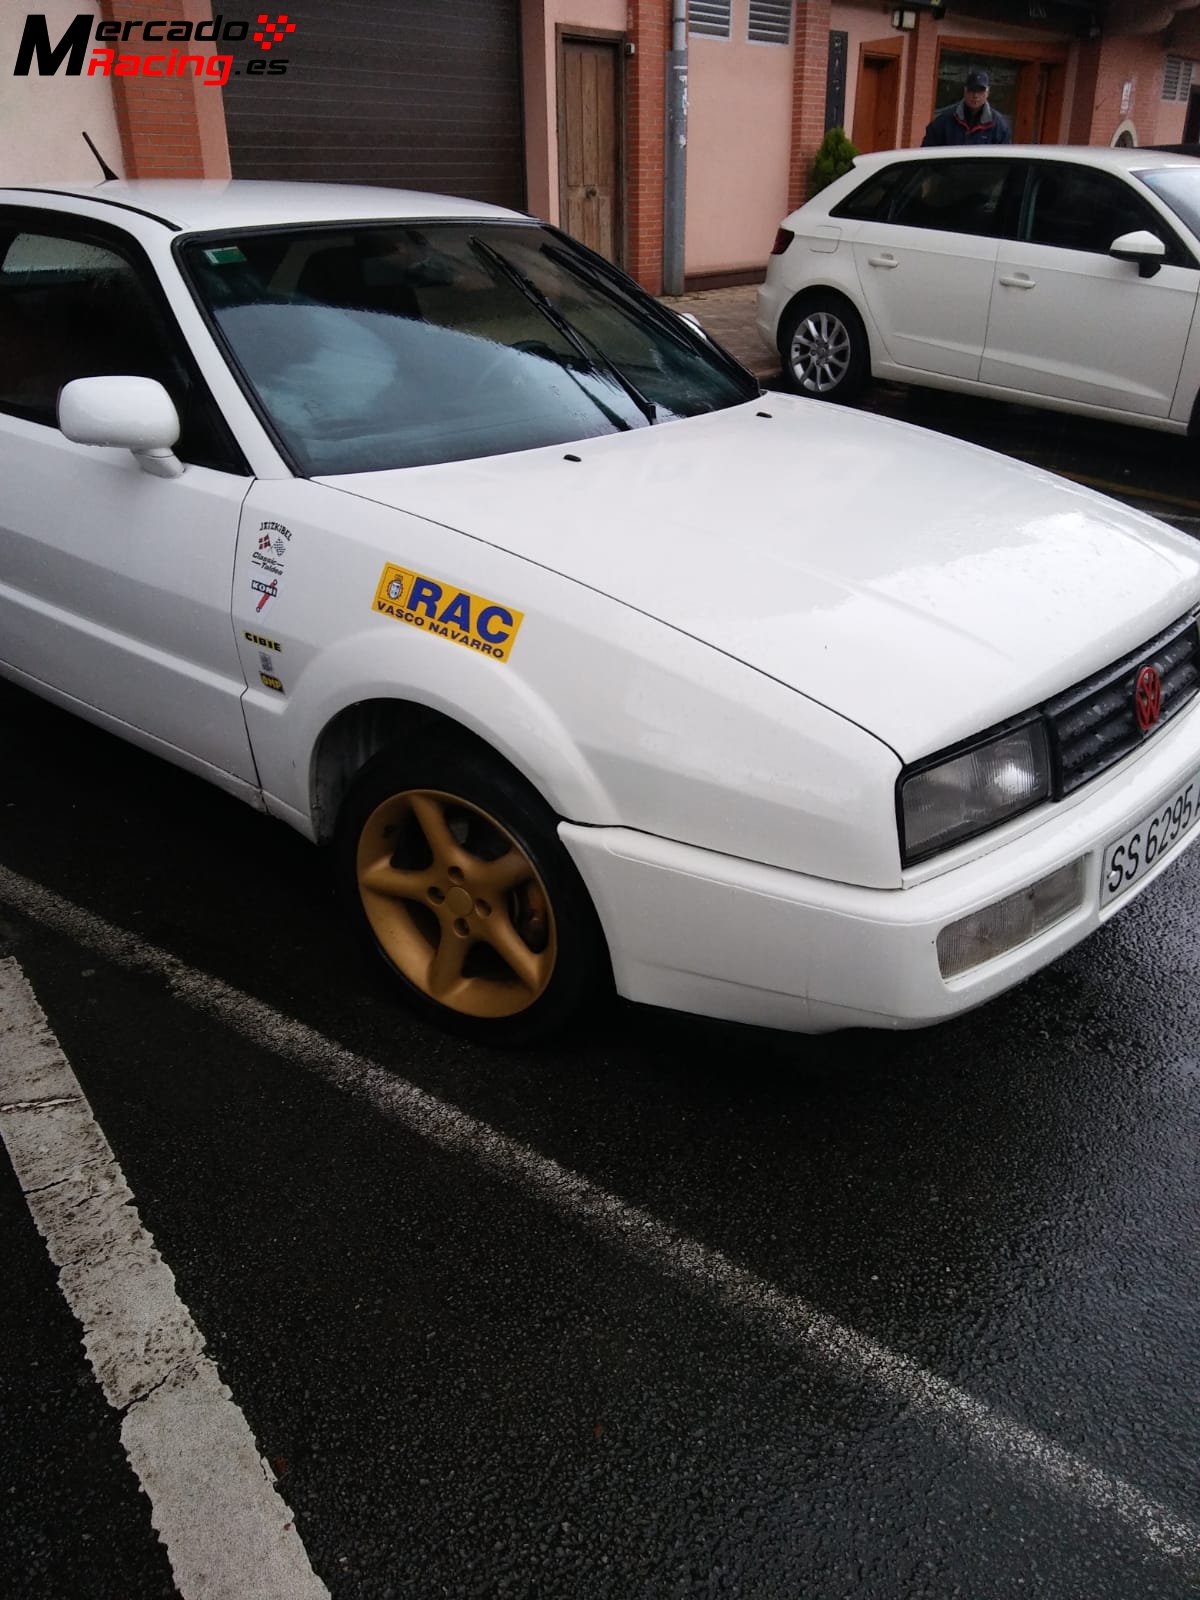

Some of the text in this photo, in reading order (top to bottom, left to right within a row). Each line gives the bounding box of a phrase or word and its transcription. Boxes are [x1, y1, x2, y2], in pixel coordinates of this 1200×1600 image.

[252, 551, 278, 566] Classic
[251, 581, 277, 597] KONI
[406, 576, 514, 644] RAC
[377, 600, 504, 658] VASCO NAVARRO
